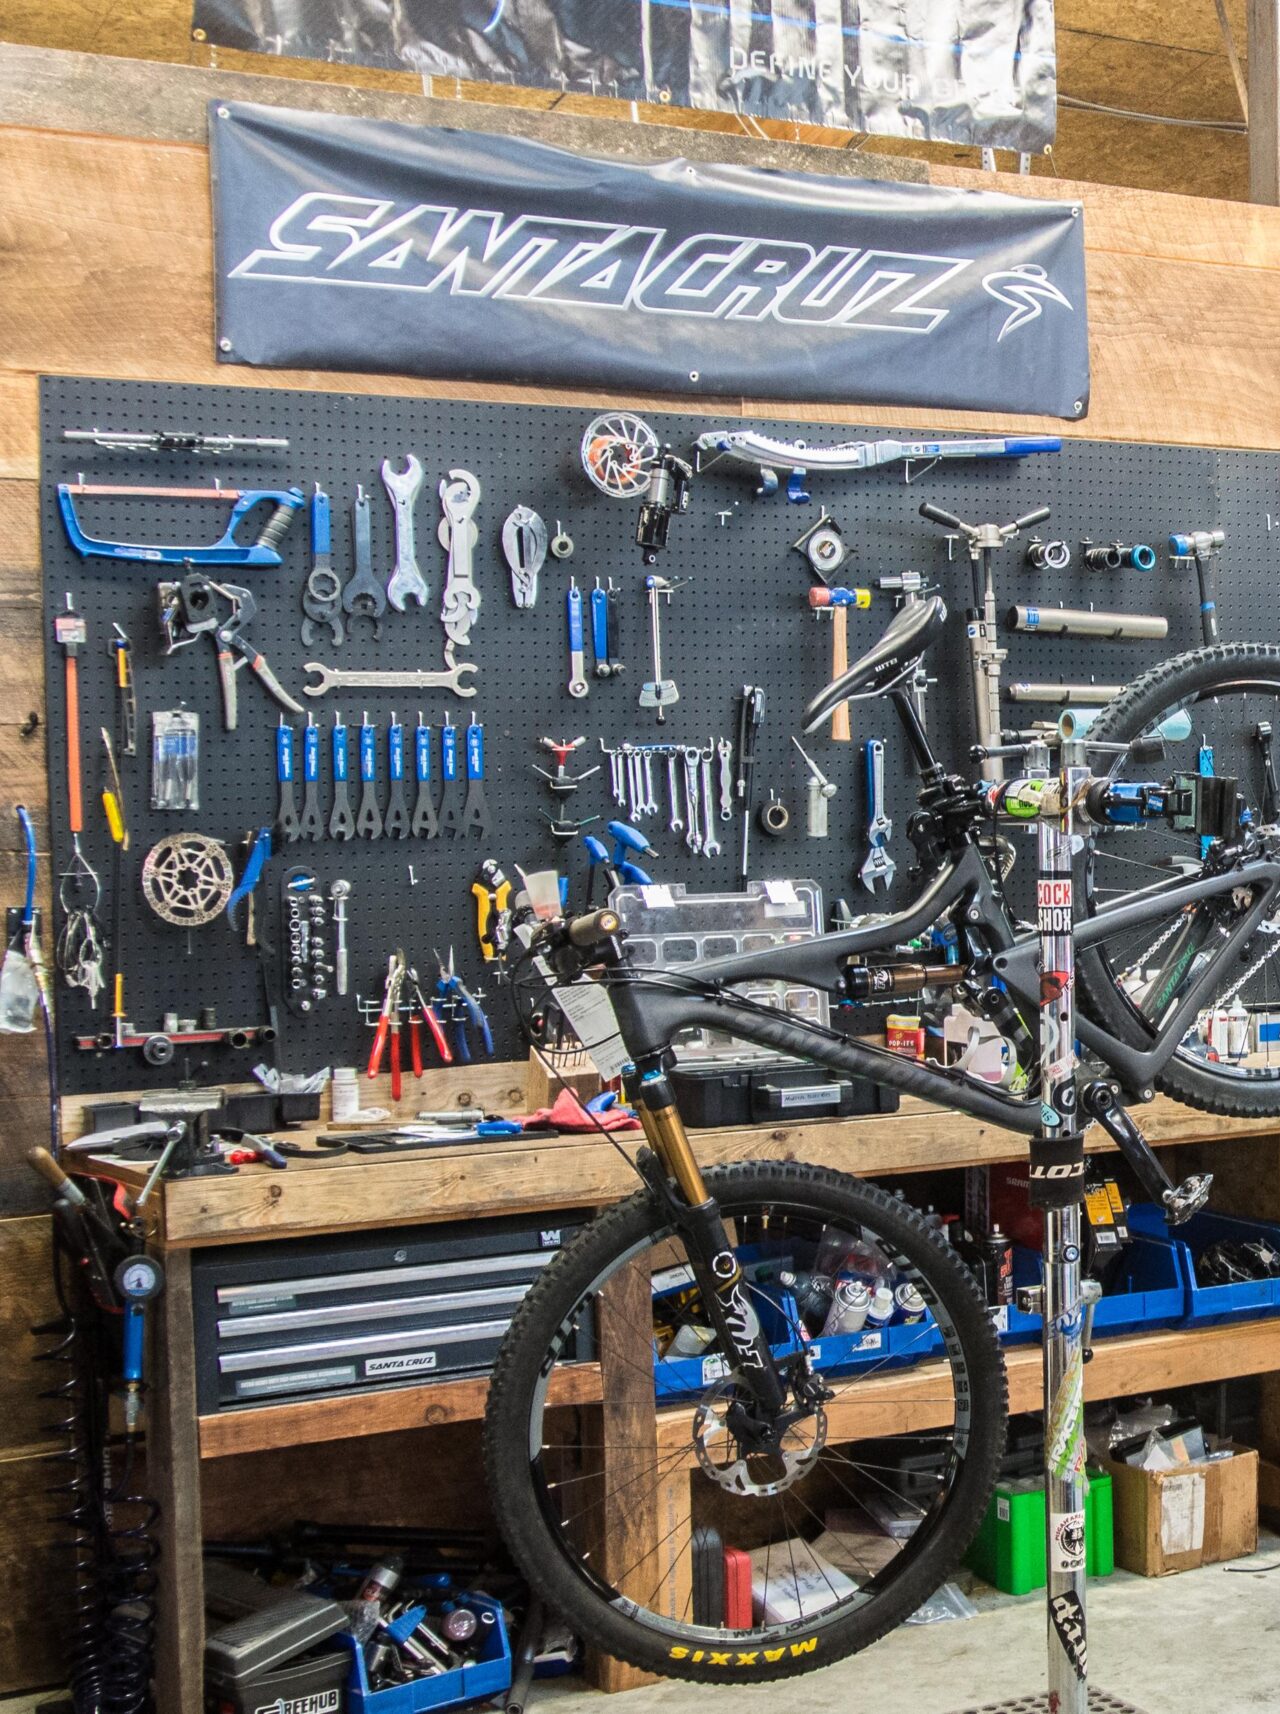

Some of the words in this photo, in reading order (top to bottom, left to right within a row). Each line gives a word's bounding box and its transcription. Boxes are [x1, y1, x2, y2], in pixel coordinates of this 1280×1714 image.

[729, 46, 832, 80] DEFINE
[1038, 908, 1072, 932] SHOX
[1029, 1160, 1084, 1179] COT
[368, 1360, 404, 1373] SANTA
[405, 1355, 434, 1368] CRUZ
[668, 1636, 818, 1666] MAXXIS
